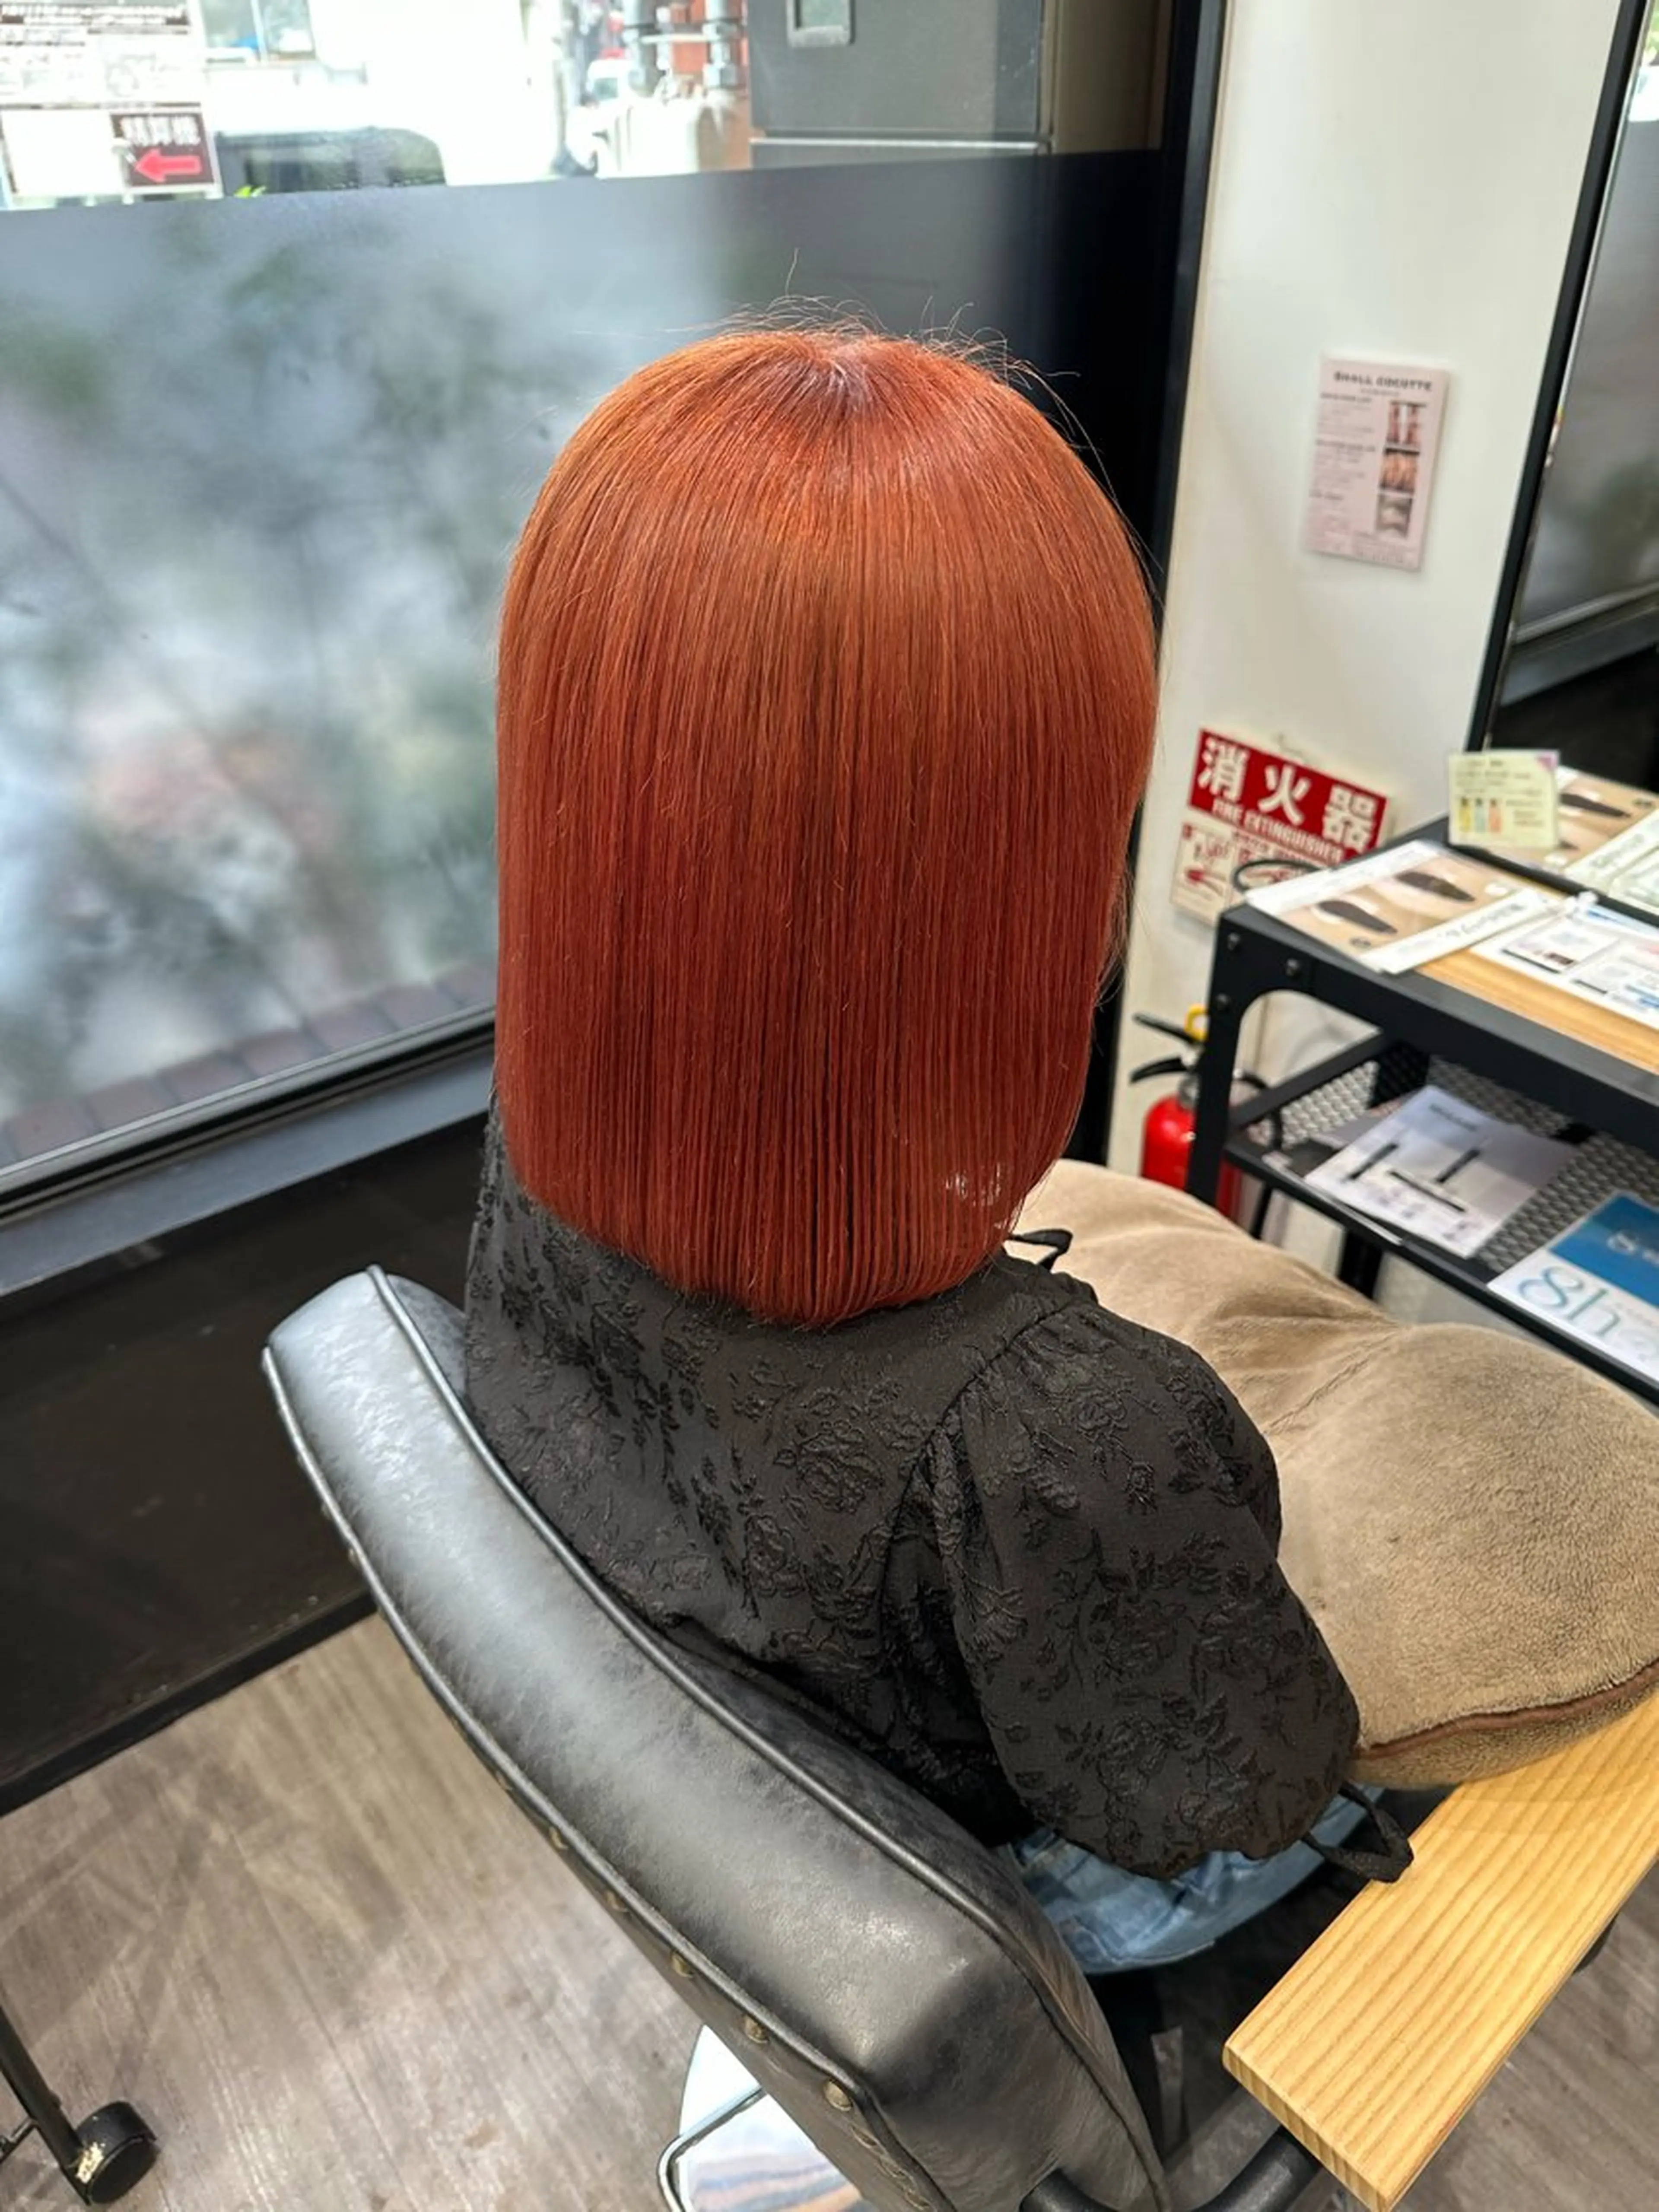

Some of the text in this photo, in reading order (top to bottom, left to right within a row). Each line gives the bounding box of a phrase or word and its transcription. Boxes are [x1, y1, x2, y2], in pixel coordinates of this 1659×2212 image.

[1197, 737, 1378, 853] 消火器
[1212, 798, 1243, 823] FIRE
